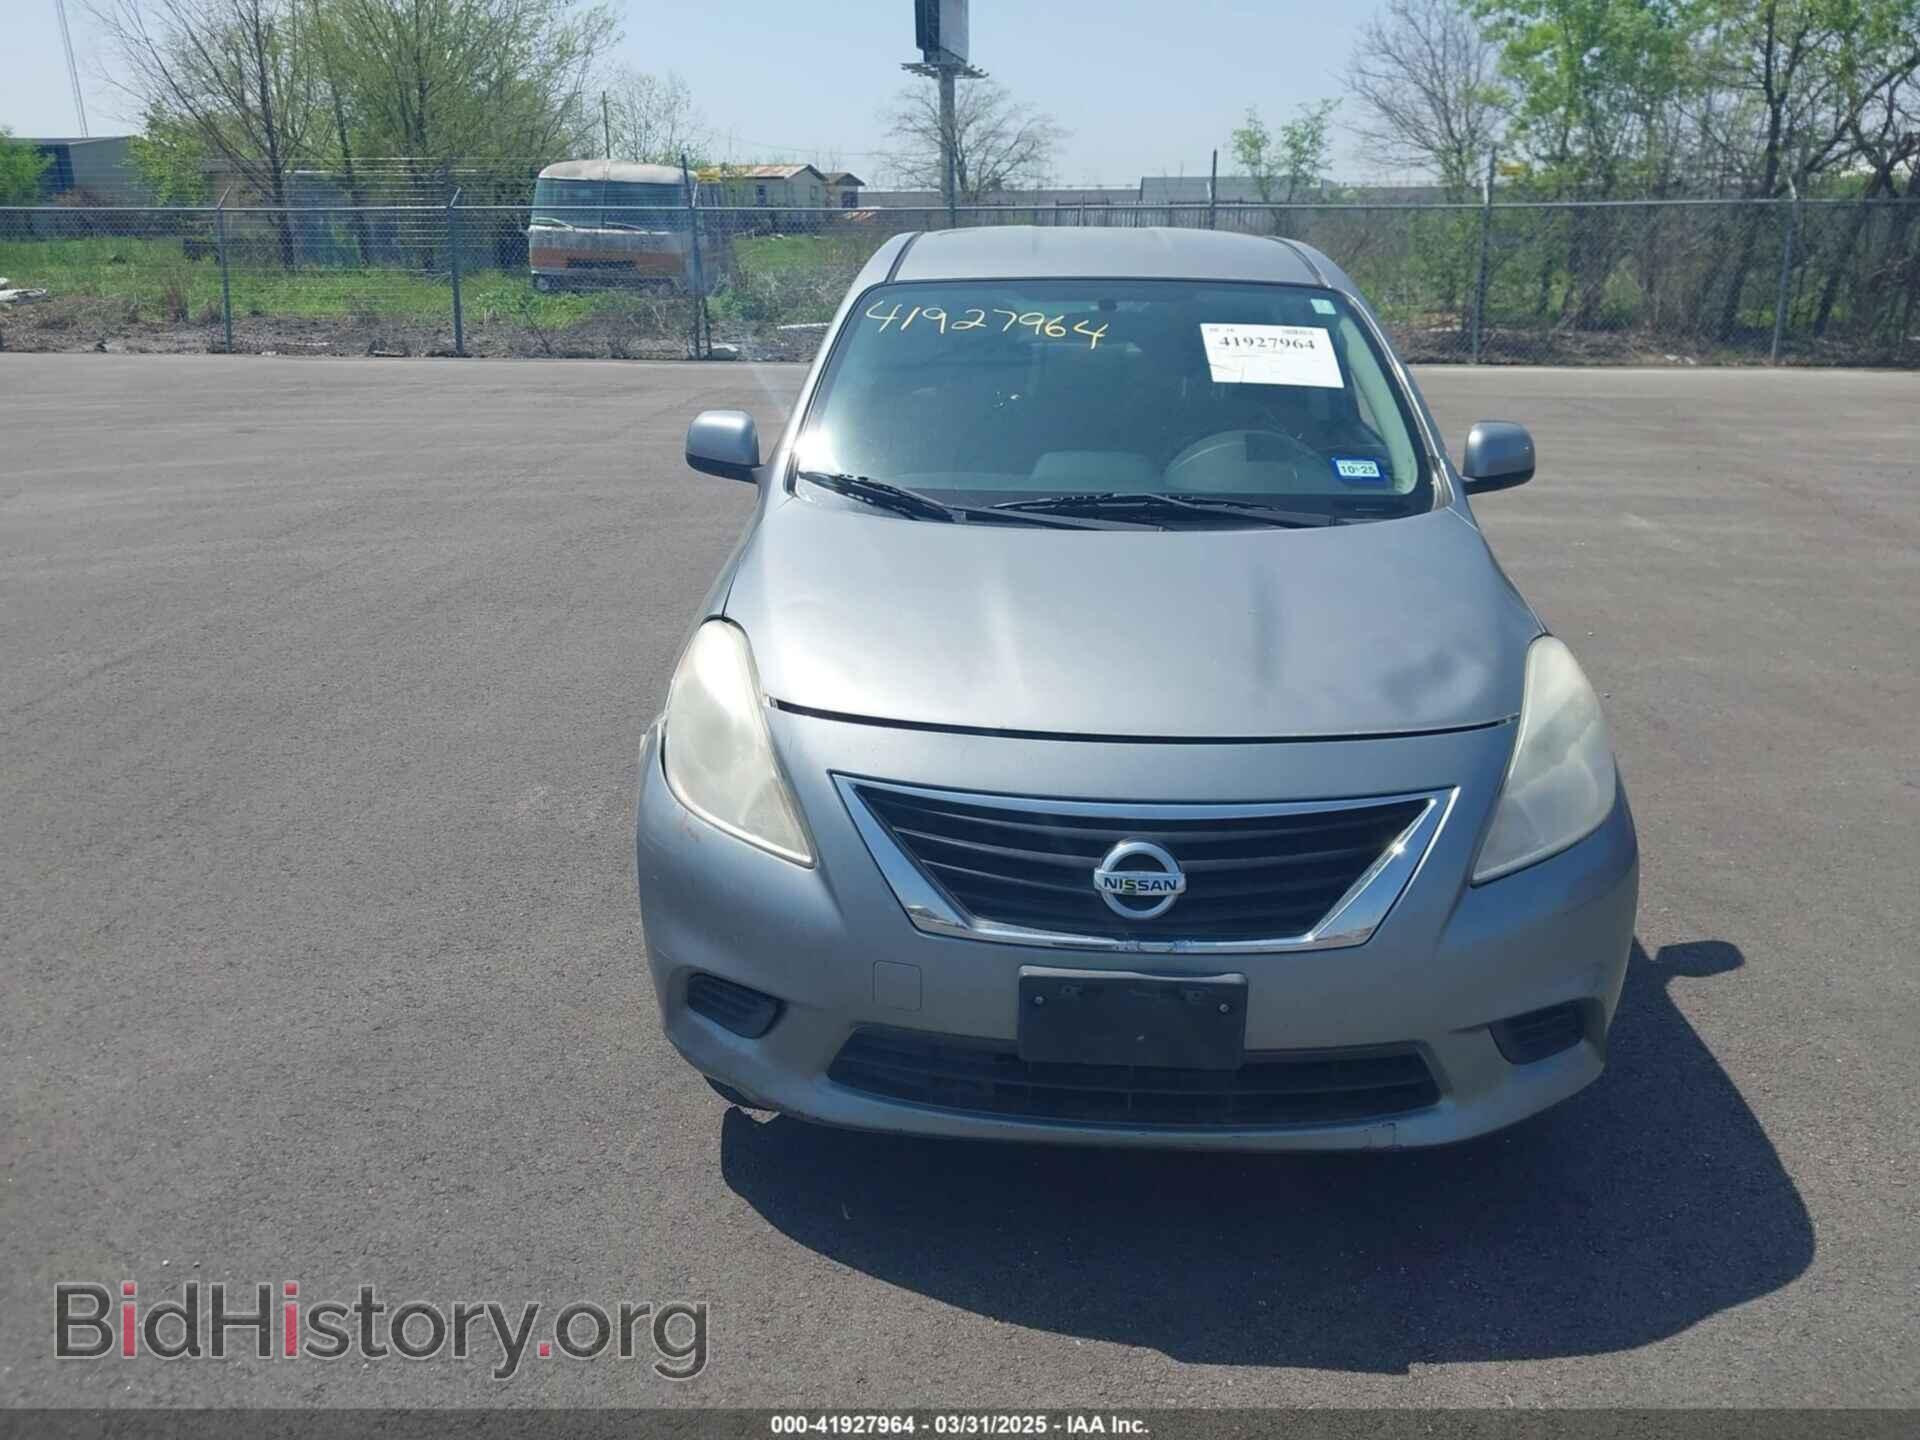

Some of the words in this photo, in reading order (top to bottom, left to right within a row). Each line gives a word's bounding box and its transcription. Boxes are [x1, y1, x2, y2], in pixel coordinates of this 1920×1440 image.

[865, 300, 1109, 350] 41927964
[1219, 336, 1316, 350] 41927964
[1103, 877, 1177, 891] NISSAN
